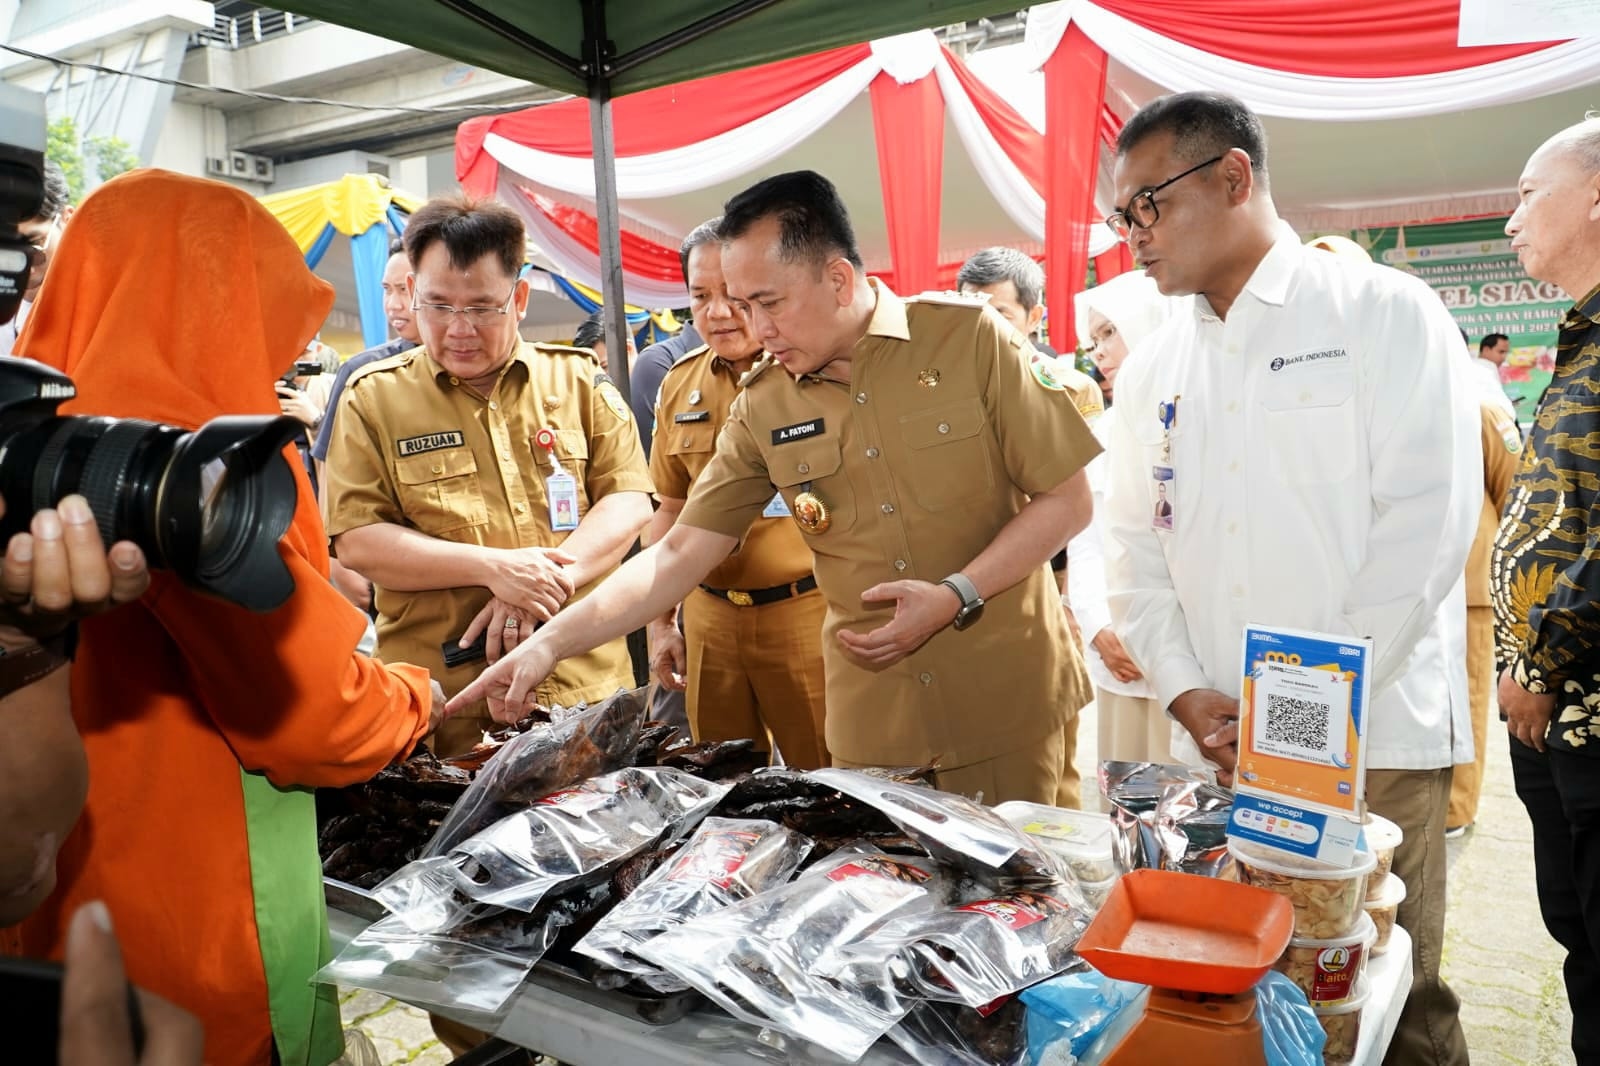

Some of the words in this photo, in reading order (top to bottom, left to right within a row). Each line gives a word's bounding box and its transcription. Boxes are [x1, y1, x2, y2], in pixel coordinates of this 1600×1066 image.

[1482, 282, 1567, 305] SIAG
[1285, 354, 1304, 365] BANK
[1306, 349, 1346, 361] INDONESIA
[40, 382, 76, 398] Nikon
[780, 430, 788, 439] A.
[789, 423, 815, 437] FATONI
[406, 433, 456, 452] RUZUAN
[1258, 801, 1271, 810] we
[1272, 805, 1304, 819] accept
